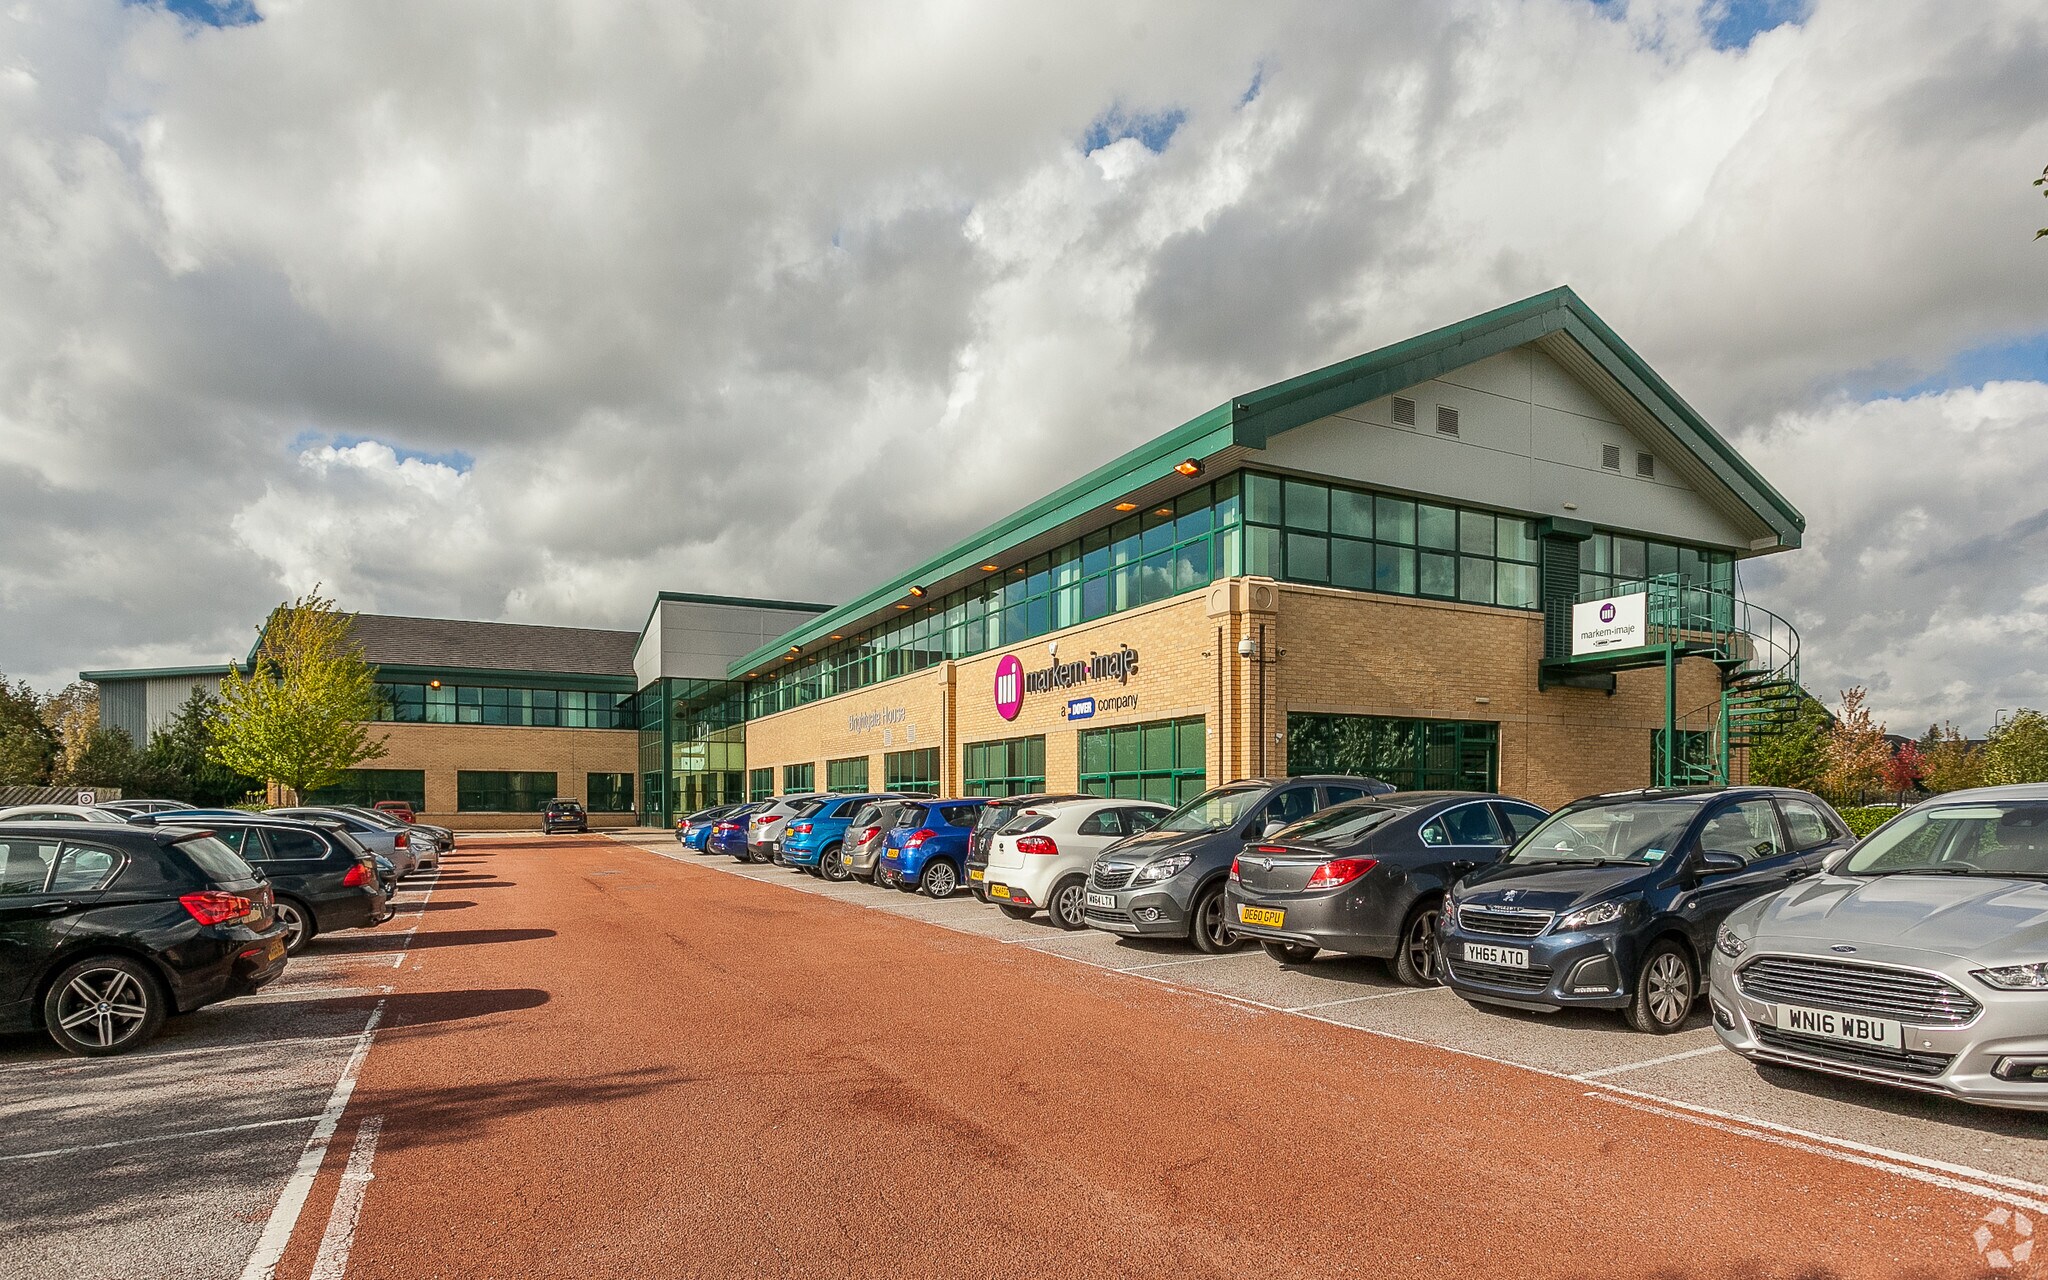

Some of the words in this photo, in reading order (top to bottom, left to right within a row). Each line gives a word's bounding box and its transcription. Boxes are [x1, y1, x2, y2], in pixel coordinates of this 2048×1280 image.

[1060, 705, 1066, 717] a
[1071, 700, 1093, 716] DOVER
[1097, 694, 1139, 712] company
[882, 706, 906, 725] House
[1101, 896, 1113, 907] LTX
[1244, 908, 1263, 921] DE60
[1264, 911, 1281, 924] GPU
[1469, 946, 1498, 962] YH65
[1500, 950, 1523, 965] ATO
[1789, 1009, 1835, 1033] WN16
[1841, 1017, 1885, 1041] WBU
